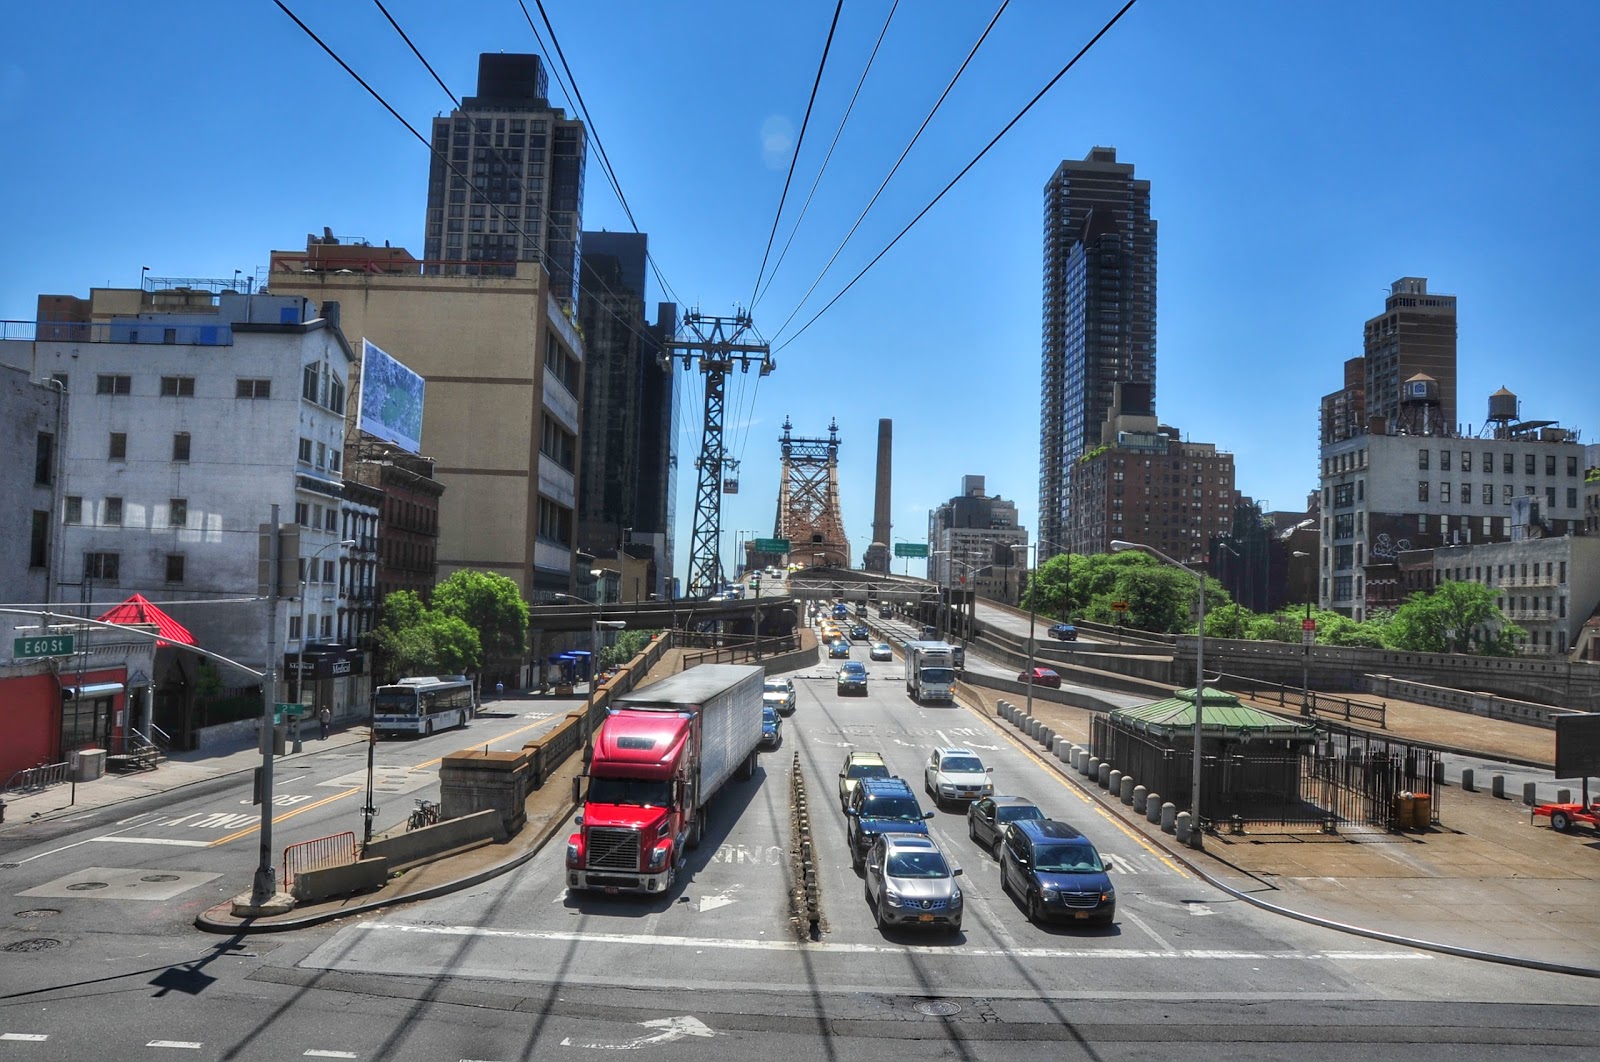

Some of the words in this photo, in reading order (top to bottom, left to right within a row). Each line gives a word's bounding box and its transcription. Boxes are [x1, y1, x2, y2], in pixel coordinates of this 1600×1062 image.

[24, 641, 31, 654] E
[34, 640, 48, 653] 60
[51, 639, 63, 652] St
[282, 704, 288, 713] 2
